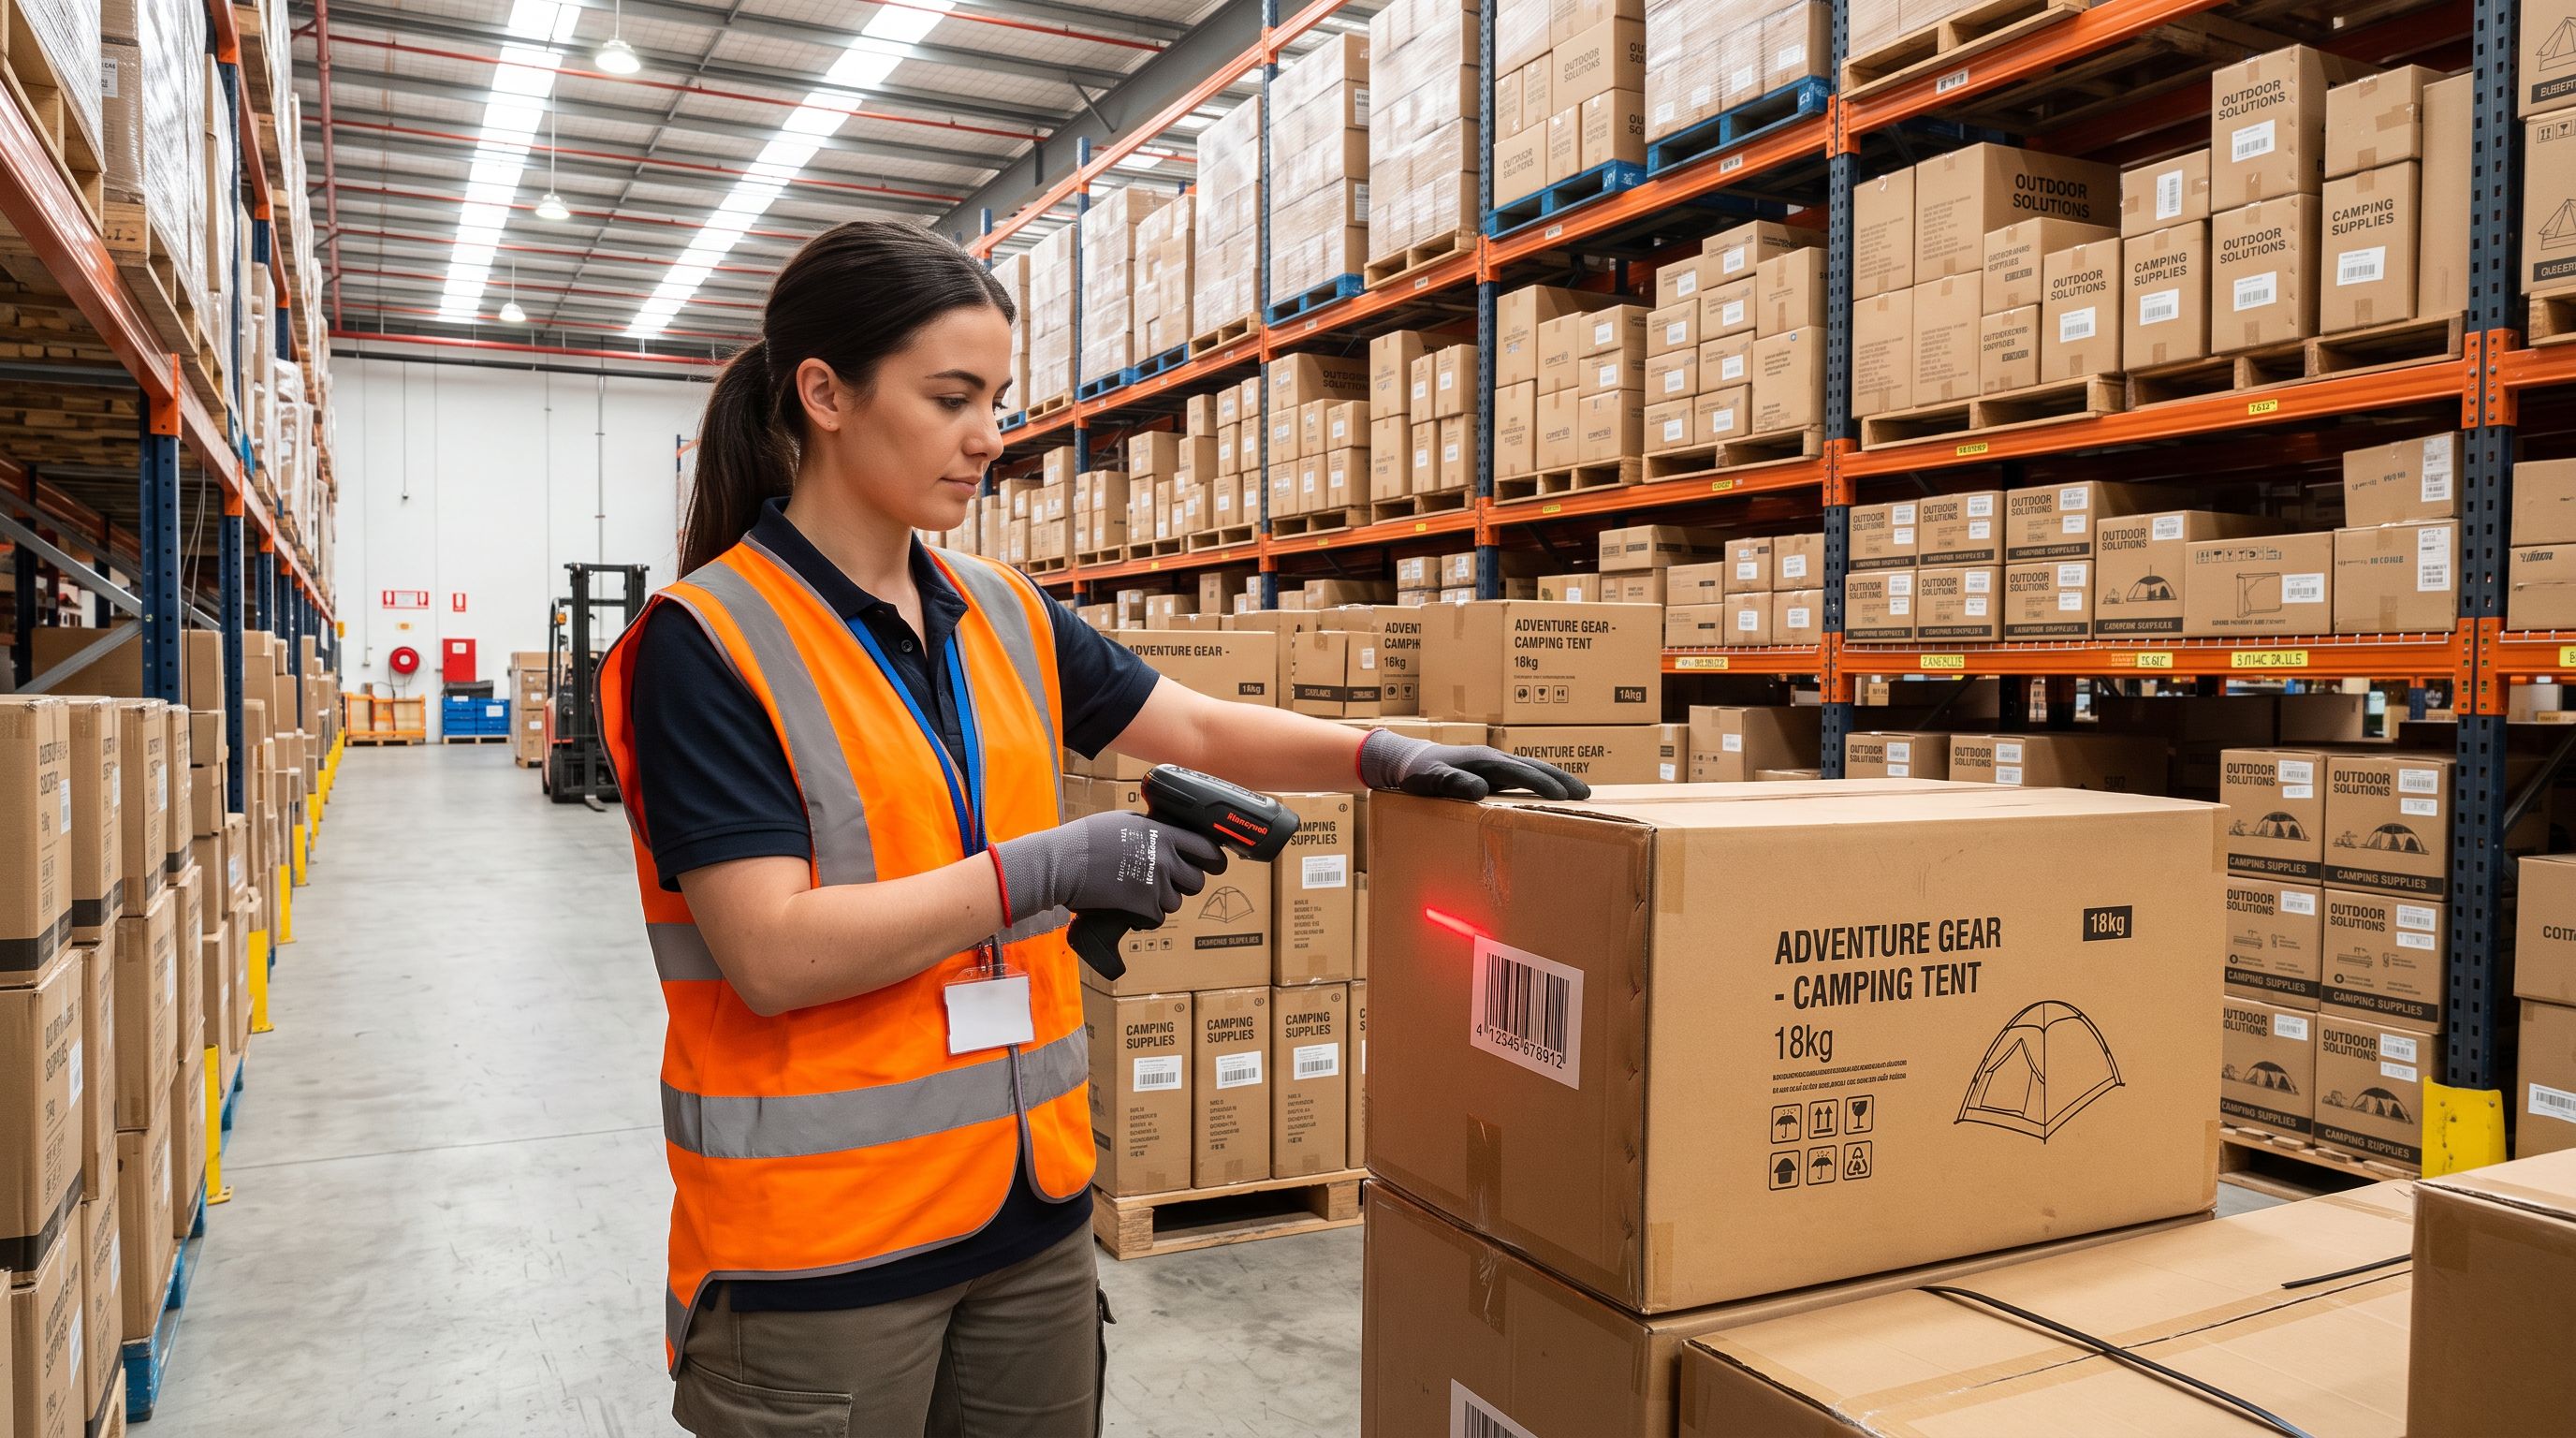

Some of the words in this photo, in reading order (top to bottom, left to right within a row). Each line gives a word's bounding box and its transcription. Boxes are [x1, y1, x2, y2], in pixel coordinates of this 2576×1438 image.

[1630, 42, 1646, 53] OU
[1564, 48, 1599, 72] OUTDOOR
[2222, 80, 2281, 107] OUTDOOR
[2217, 92, 2286, 120] SOLUTIONS
[1630, 114, 1646, 125] OU
[2015, 172, 2087, 198] OUTDOOR
[2012, 194, 2090, 219] SOLUTIONS
[2332, 198, 2394, 223] CAMPING
[2331, 212, 2394, 237] SUPPLIES
[2222, 227, 2282, 251] OUTDOOR
[2219, 240, 2286, 265] SOLUTIONS
[2134, 252, 2187, 274] CAMPING
[2053, 269, 2104, 289] OUTDOOR
[2134, 265, 2188, 287] SUPPLIES
[2050, 280, 2107, 301] SOLUTIONS
[2012, 494, 2052, 506] OUTDOOR
[2011, 504, 2053, 516] SOLUTIONS
[2102, 528, 2146, 541] OUTDOOR
[2101, 539, 2147, 551] SOLUTIONS
[2010, 582, 2049, 593] SOLUTIONS
[1515, 619, 1578, 633] ADVENTURE
[1581, 621, 1609, 633] GEAR
[1194, 646, 1222, 656] GEAR
[1515, 637, 1563, 649] CAMPING
[1566, 637, 1592, 650] TENT
[1514, 656, 1539, 670] 18kg
[1577, 746, 1604, 757] GEAR
[2226, 774, 2276, 786] SOLUTIONS
[2334, 770, 2391, 785] OUTDOOR
[2334, 785, 2391, 797] SOLUTIONS
[1296, 821, 1337, 832] AMPING
[1290, 834, 1337, 845] SUPPLIES
[2267, 860, 2307, 874] SUPPLIES
[2380, 874, 2426, 889] SUPPLIES
[2226, 889, 2275, 905] OUTDOOR
[2226, 902, 2275, 916] SOLUTIONS
[2330, 902, 2386, 920] OUTDOOR
[2090, 912, 2126, 936] 18kg
[2330, 916, 2386, 932] SOLUTIONS
[1775, 922, 1930, 964] ADVENTURE
[1939, 917, 2002, 952] GEAR
[1793, 968, 1912, 1010] CAMPING
[1921, 961, 1983, 998] TENT
[2227, 971, 2263, 986] CAMPING
[2266, 976, 2305, 992] SUPPLIES
[2334, 991, 2375, 1009] CAMPING
[2378, 998, 2422, 1016] SUPPLIES
[1207, 1017, 1253, 1030] CAMPING
[1285, 1012, 1330, 1025] CAMPING
[1126, 1021, 1175, 1035] CAMPING
[1285, 1024, 1331, 1039] SUPPLIES
[2223, 1020, 2267, 1037] OLUTIONS
[1126, 1035, 1176, 1049] SUPPLIES
[1207, 1029, 1254, 1044] SUPPLIES
[1774, 1024, 1834, 1064] 18kg
[2323, 1028, 2378, 1049] OUTDOOR
[1476, 1023, 1483, 1037] 4
[1523, 1043, 1563, 1070] 678912
[2322, 1041, 2378, 1063] SOLUTIONS
[2325, 1128, 2365, 1148] CAMPING
